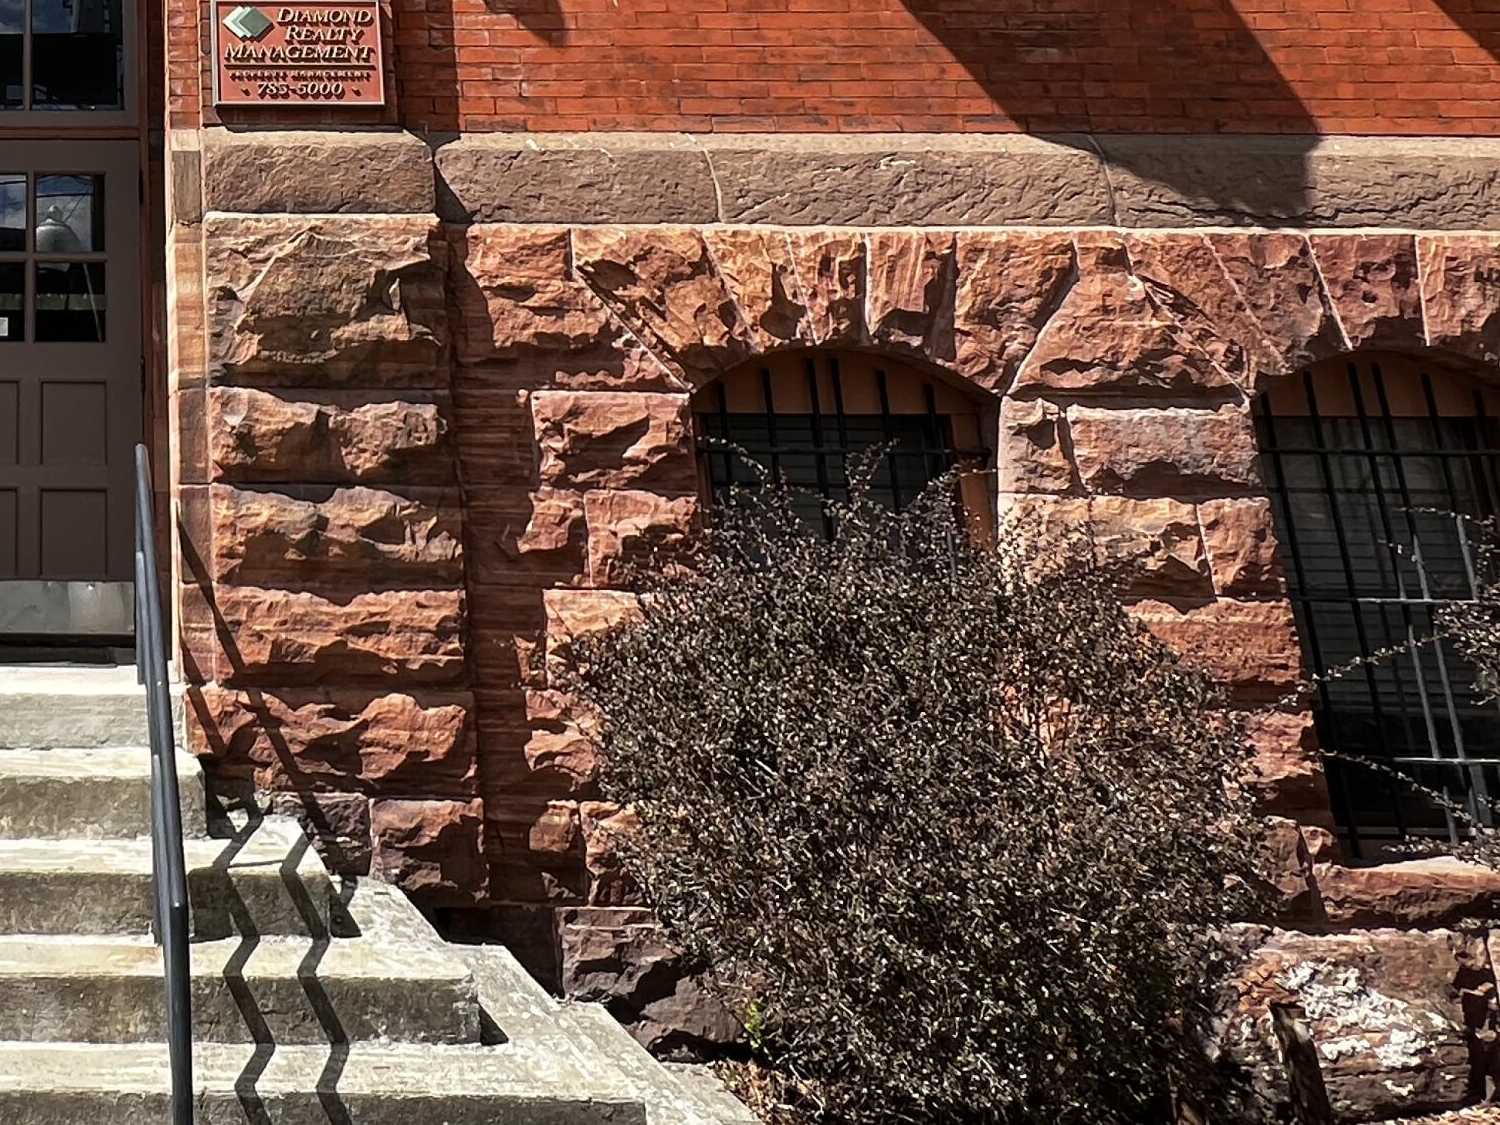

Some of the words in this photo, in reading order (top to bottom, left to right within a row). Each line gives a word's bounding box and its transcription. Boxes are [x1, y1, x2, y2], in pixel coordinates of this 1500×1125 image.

[276, 6, 373, 24] DIAMOND
[285, 25, 362, 42] REALTY
[224, 42, 375, 60] MANAGEMENT
